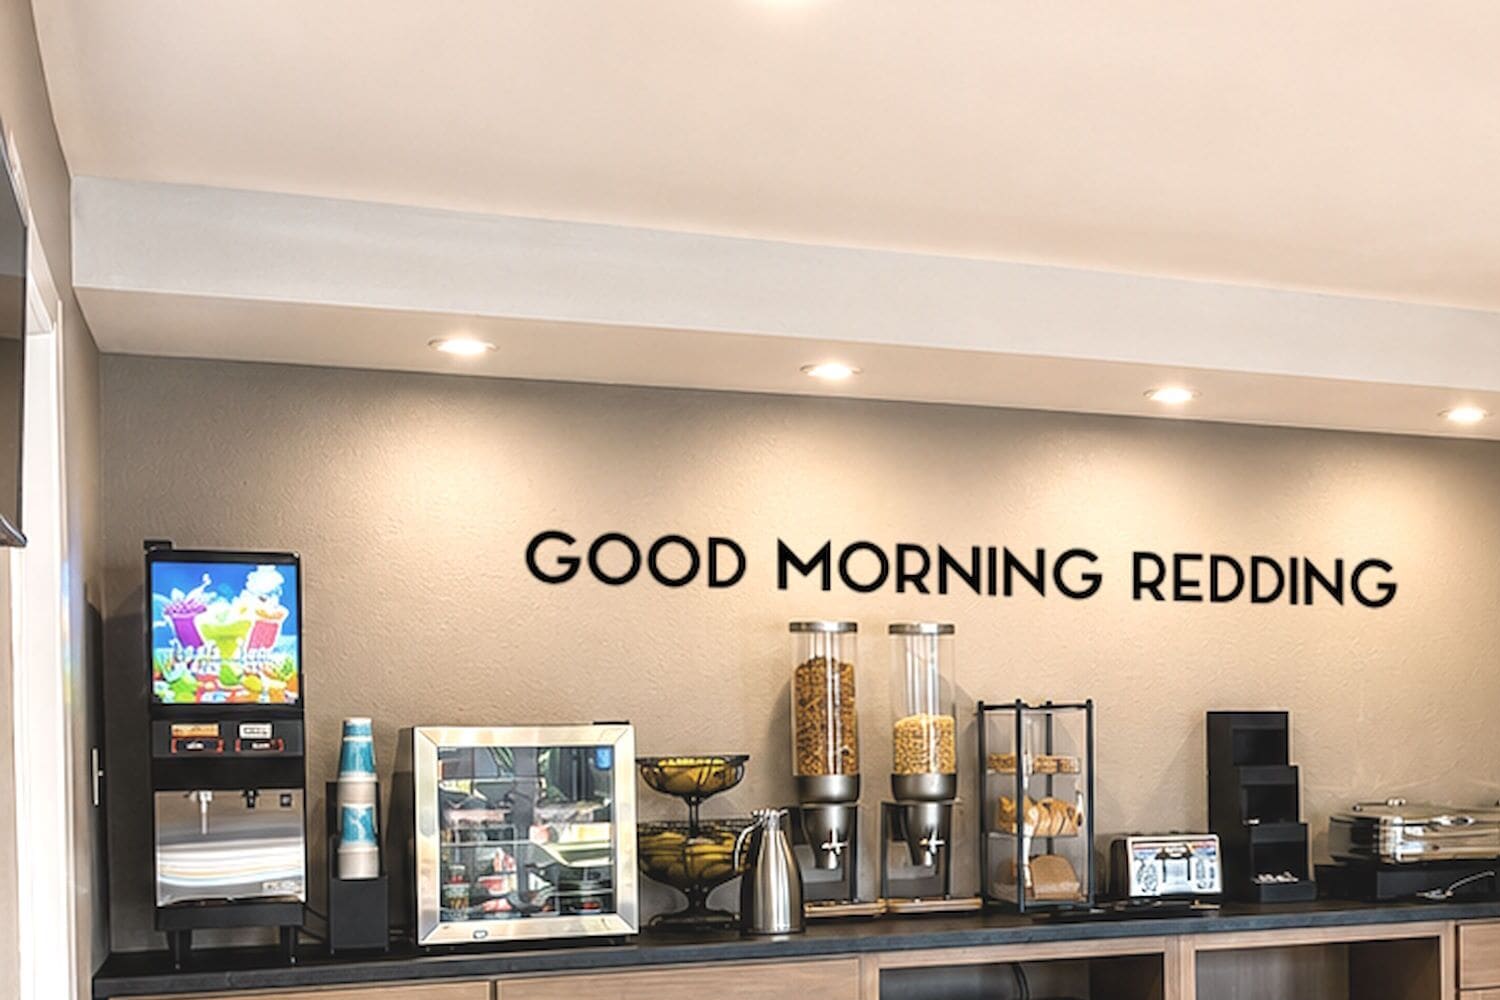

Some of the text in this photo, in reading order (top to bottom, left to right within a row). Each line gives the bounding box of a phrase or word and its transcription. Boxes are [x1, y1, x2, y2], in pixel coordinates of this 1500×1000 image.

[525, 530, 1397, 608] GOOD MORNING REDDING
